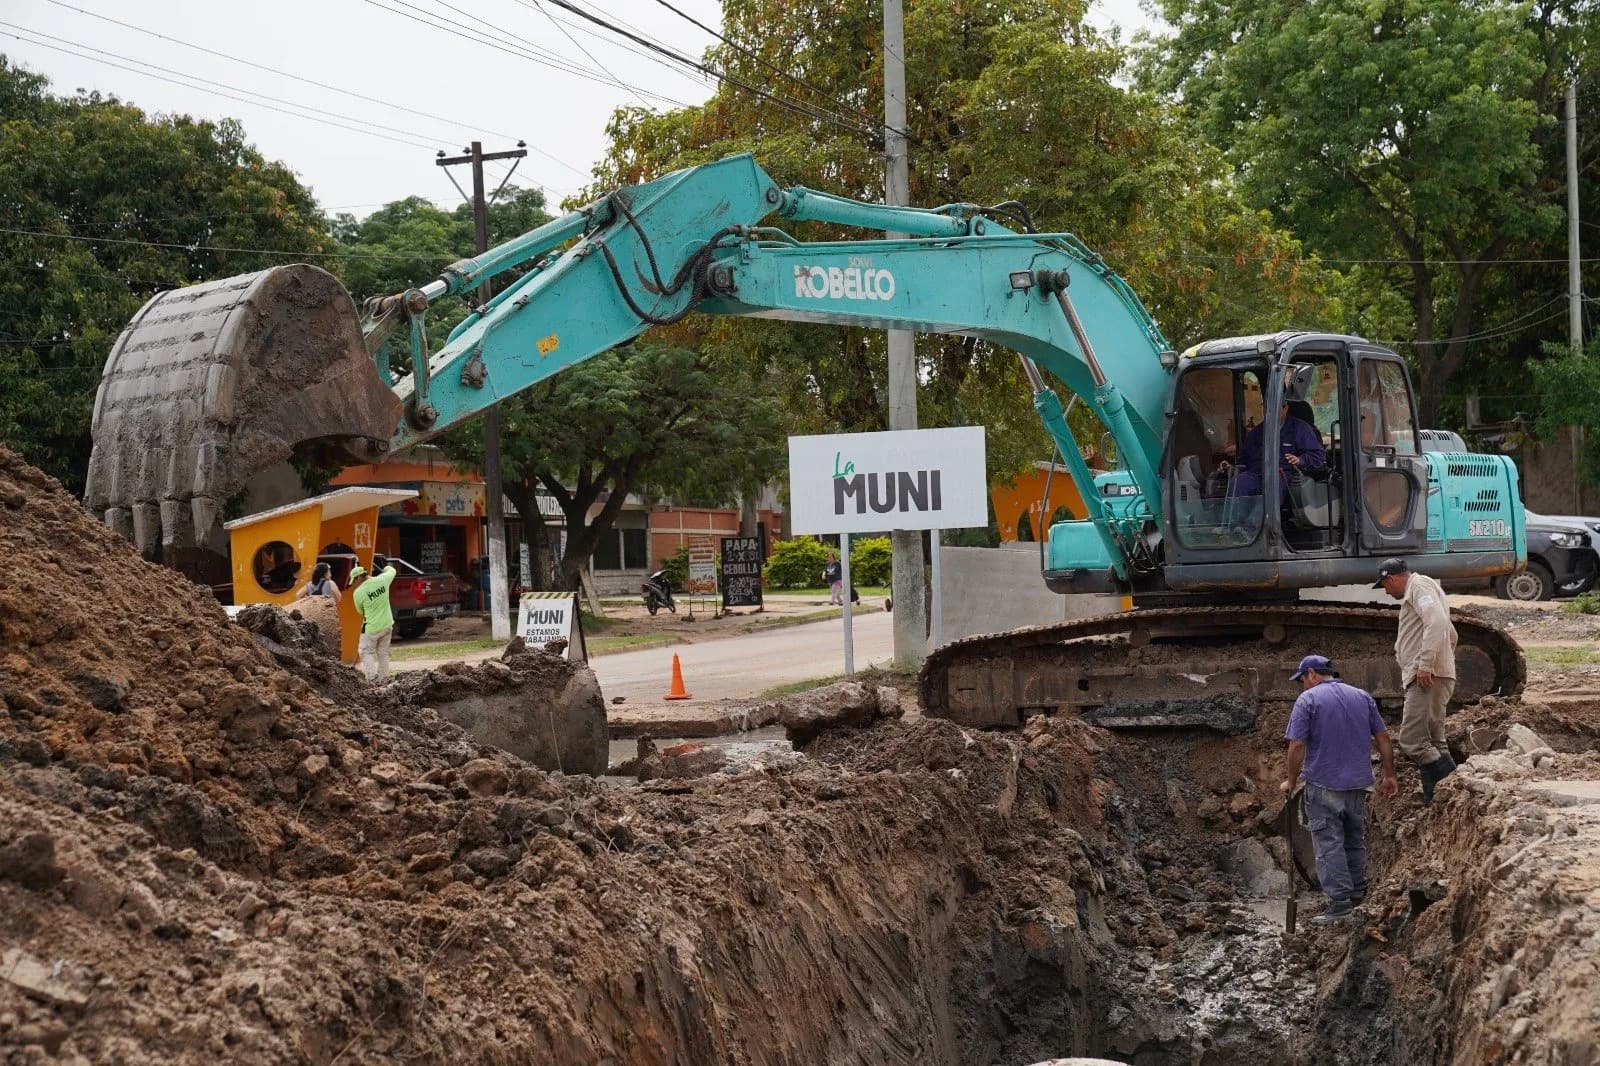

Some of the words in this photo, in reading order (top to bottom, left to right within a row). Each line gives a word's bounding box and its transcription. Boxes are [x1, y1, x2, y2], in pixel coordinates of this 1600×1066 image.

[794, 264, 896, 300] KOBELCO
[832, 451, 855, 478] La
[833, 470, 941, 515] MUNI
[725, 539, 757, 551] PAPA
[367, 586, 386, 601] MUNI
[527, 610, 564, 624] MUNI
[526, 628, 560, 636] ESTAMOS
